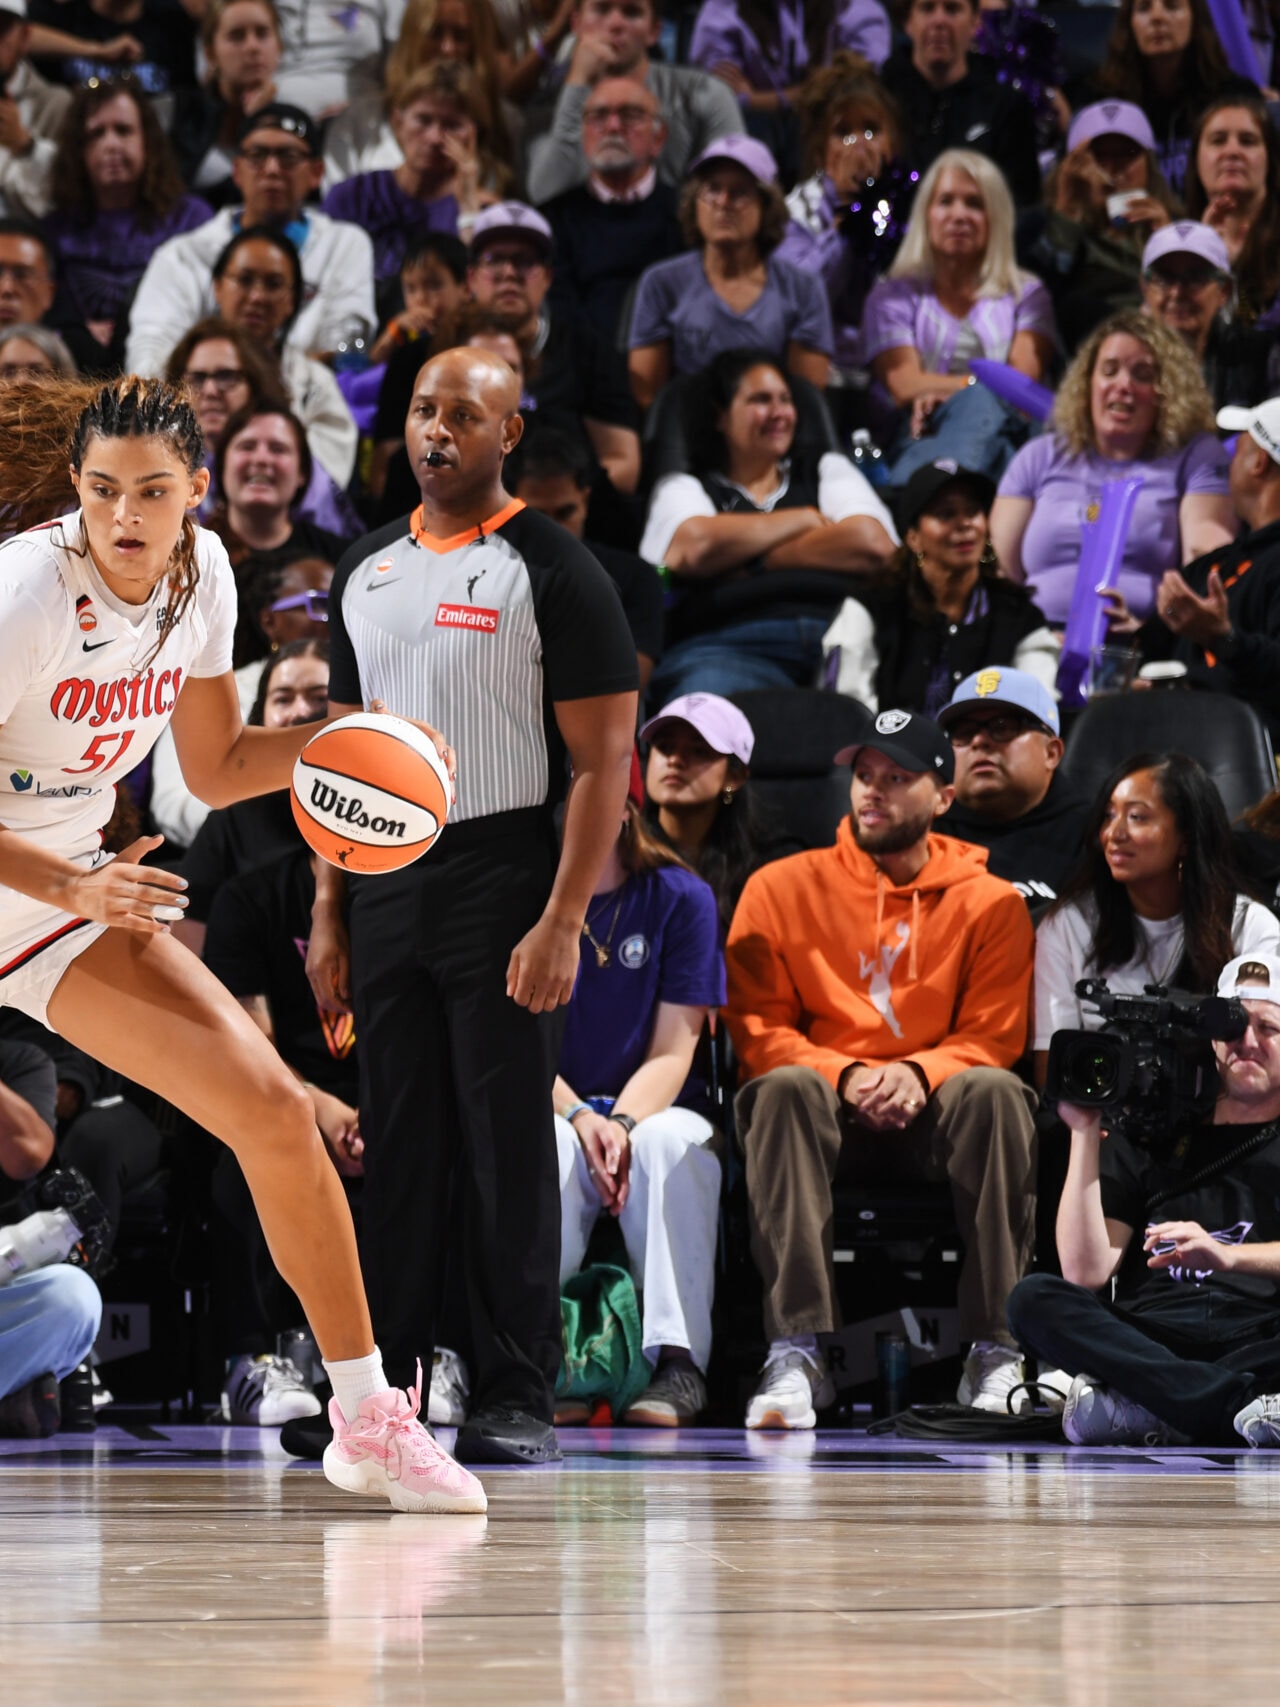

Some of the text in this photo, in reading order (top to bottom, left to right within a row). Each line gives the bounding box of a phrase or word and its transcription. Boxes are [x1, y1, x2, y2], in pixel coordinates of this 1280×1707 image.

[436, 607, 497, 629] Emirates
[60, 729, 136, 778] 51
[310, 776, 407, 838] Wilson
